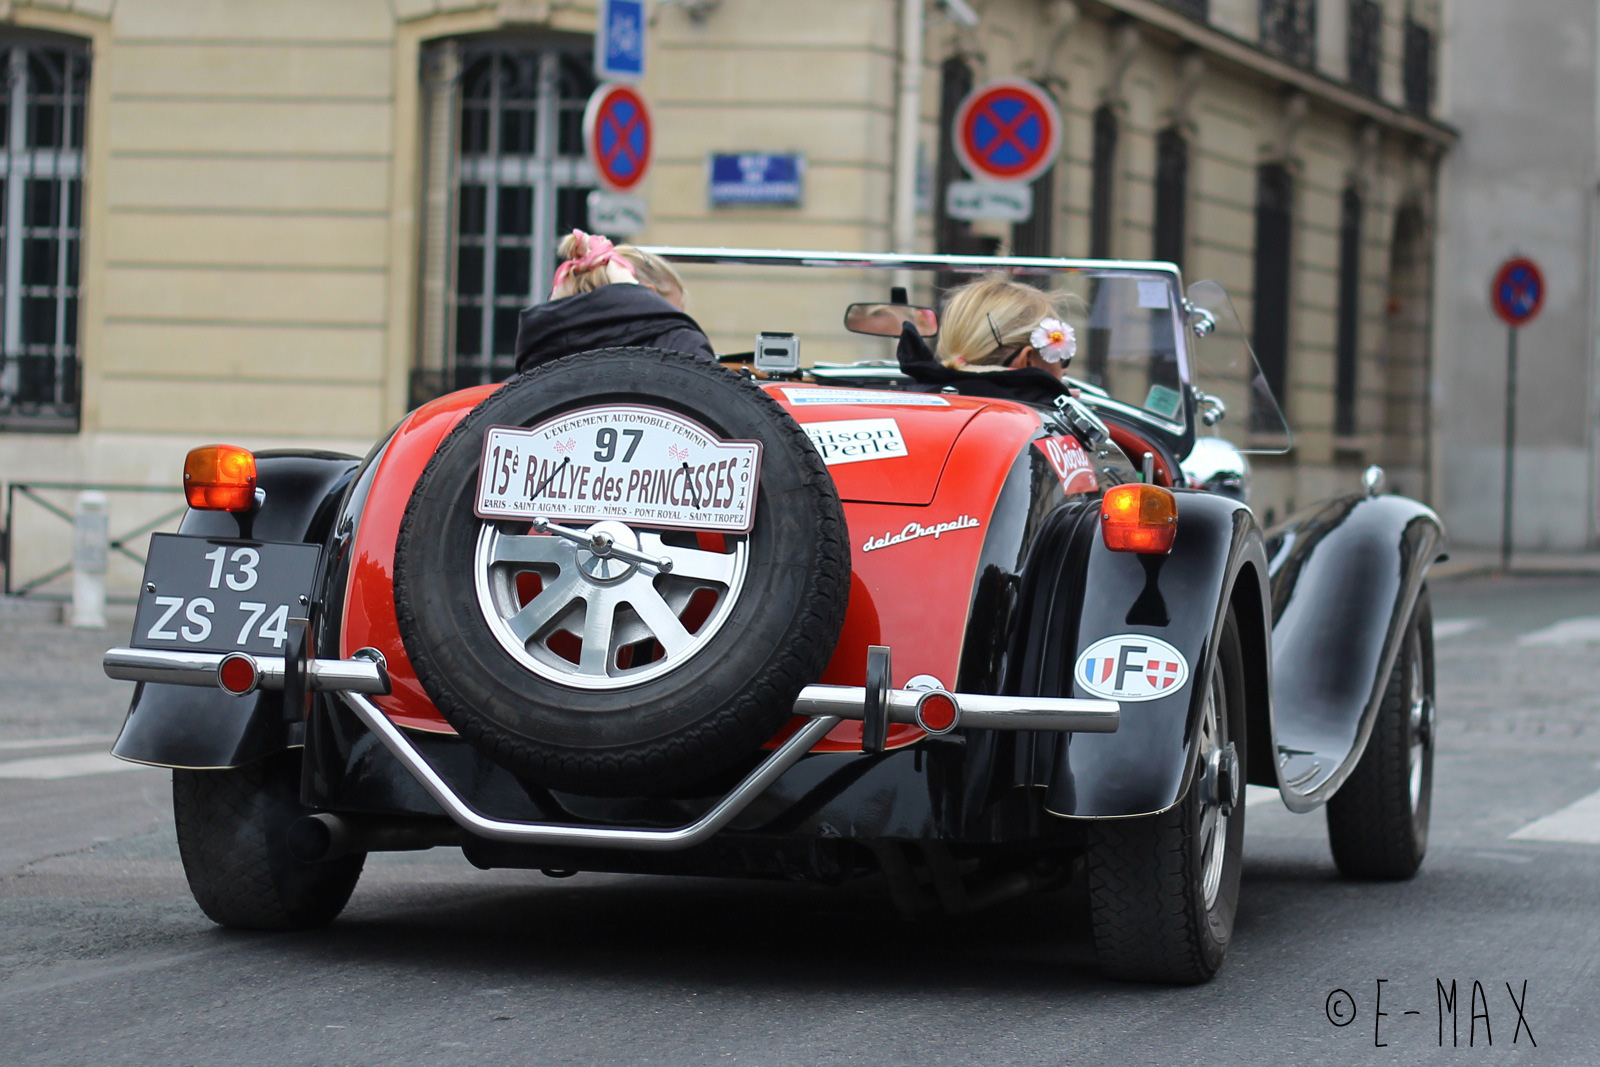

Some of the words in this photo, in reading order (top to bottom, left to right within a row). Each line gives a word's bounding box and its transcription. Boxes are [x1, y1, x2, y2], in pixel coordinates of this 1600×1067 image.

[593, 427, 644, 463] 97
[611, 414, 671, 429] AUTOMOBILE
[672, 424, 708, 449] FÉMININ
[810, 429, 895, 444] aison
[813, 439, 901, 458] Perle
[523, 455, 591, 500] RALLYE
[592, 466, 623, 502] des
[626, 457, 738, 508] PRINCESSES
[736, 458, 751, 511] 2014
[483, 499, 506, 509] PARIS
[513, 501, 536, 511] SAINT
[537, 503, 566, 513] AIGNAN
[574, 504, 596, 513] VICHY
[634, 508, 657, 518] PONT
[657, 510, 681, 519] ROYAL
[689, 512, 712, 521] SAINT
[714, 513, 744, 523] TROPEZ
[204, 546, 260, 591] 13
[147, 596, 215, 643] ZS
[236, 601, 289, 648] 74
[1114, 645, 1148, 690] F
